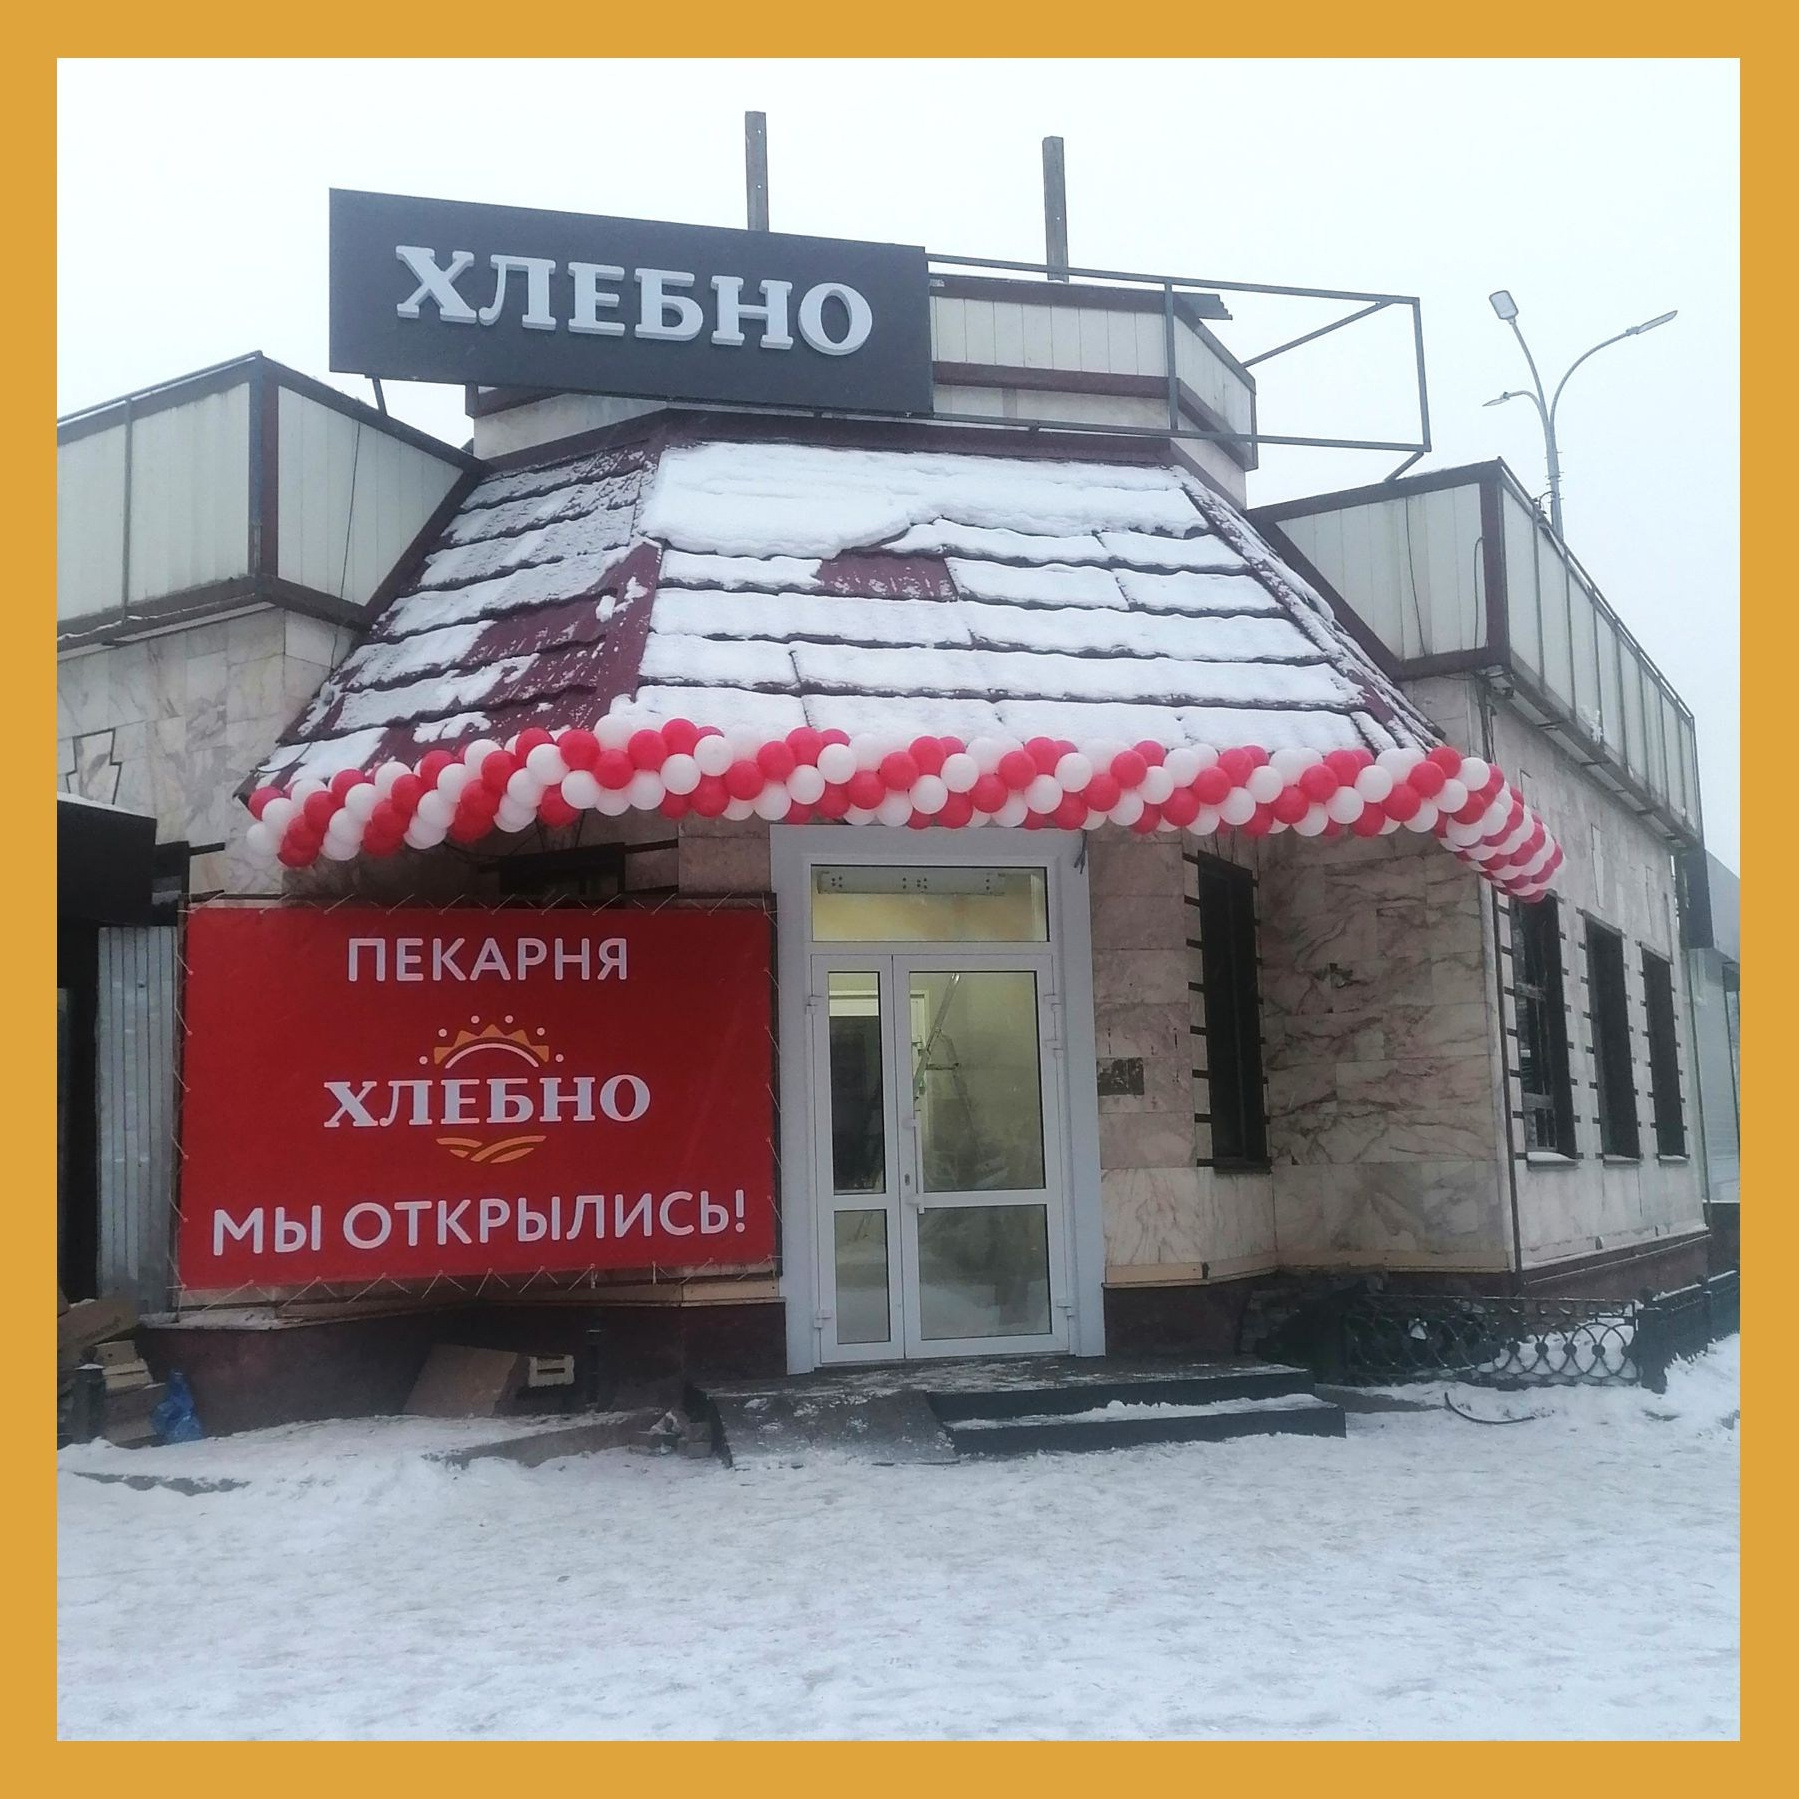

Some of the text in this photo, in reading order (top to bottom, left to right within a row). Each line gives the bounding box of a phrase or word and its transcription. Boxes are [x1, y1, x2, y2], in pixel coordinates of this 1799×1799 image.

[395, 245, 873, 355] ХЛЕБНО
[348, 938, 628, 981] ПЕКАРНЯ
[324, 1075, 651, 1127] ХЛЕБНО
[213, 1189, 746, 1256] МЫ ОТКРЫЛИСЬ!
